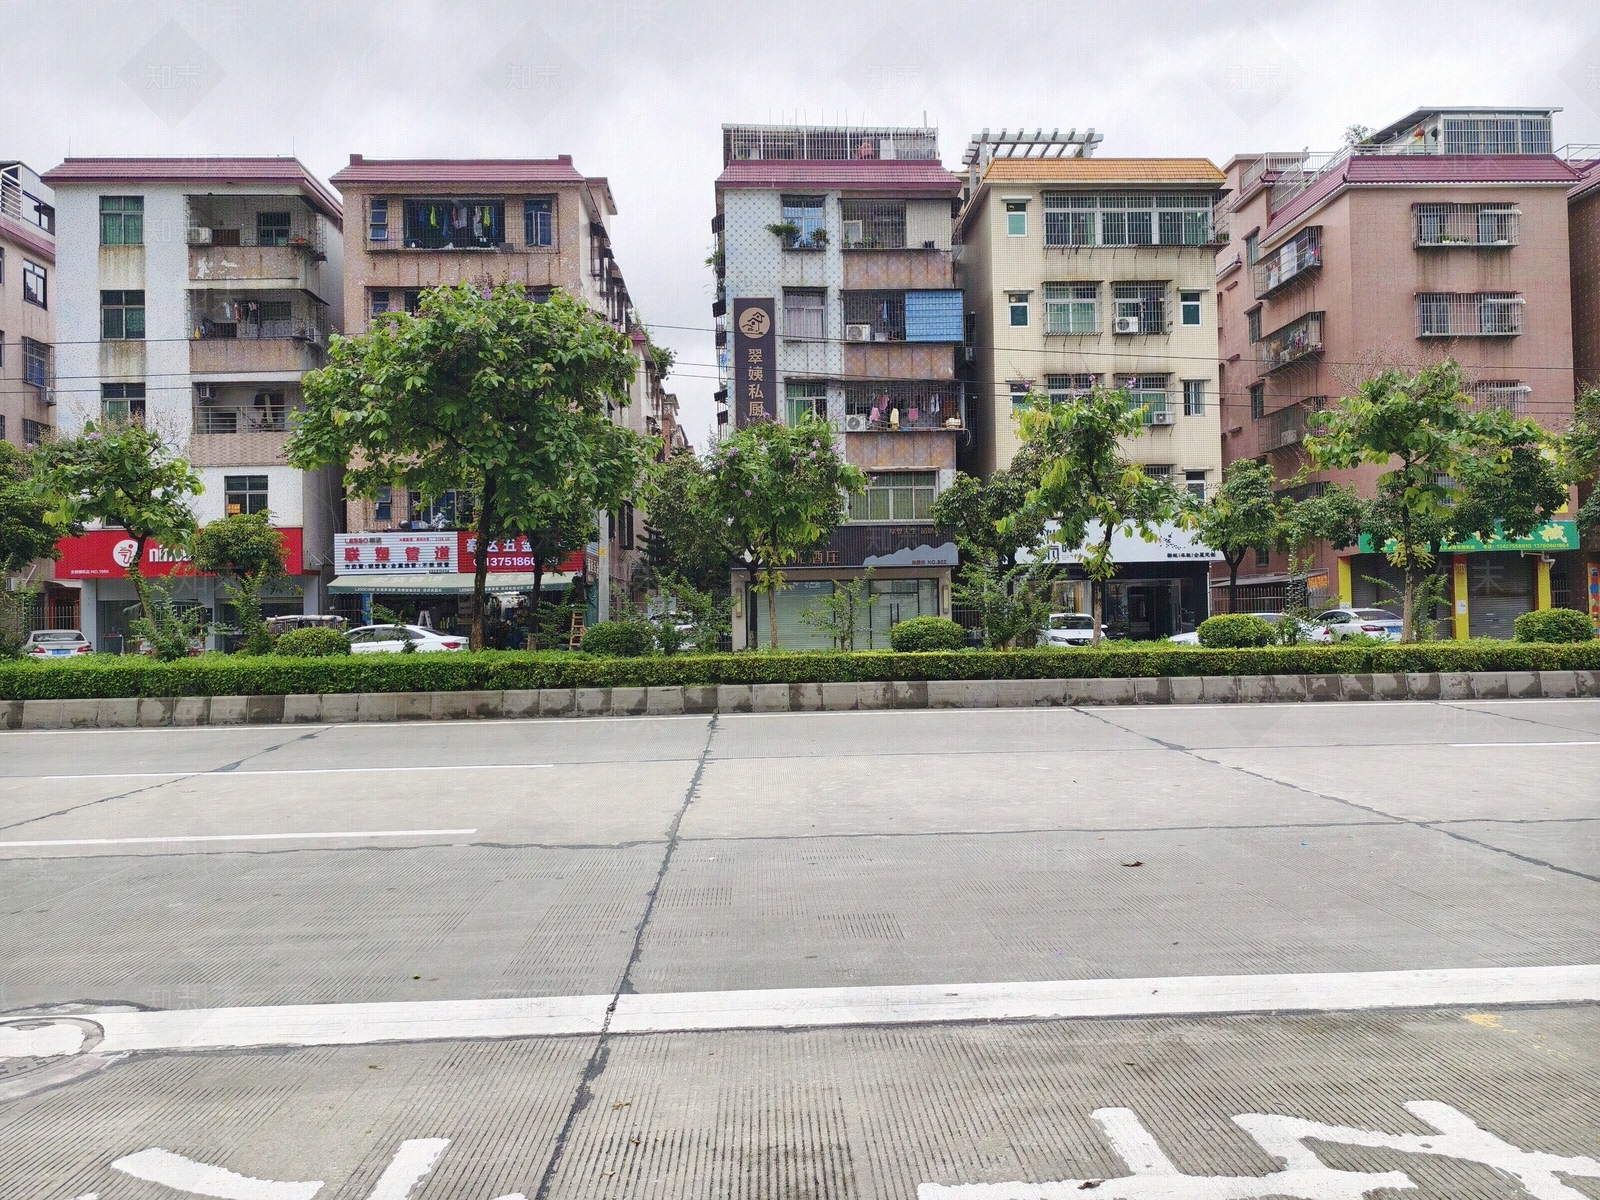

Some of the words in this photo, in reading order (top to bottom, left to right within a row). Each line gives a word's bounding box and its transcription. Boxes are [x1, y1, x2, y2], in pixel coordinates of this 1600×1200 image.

[747, 348, 764, 418] 翠姨私厨
[344, 545, 450, 562] 联塑管道
